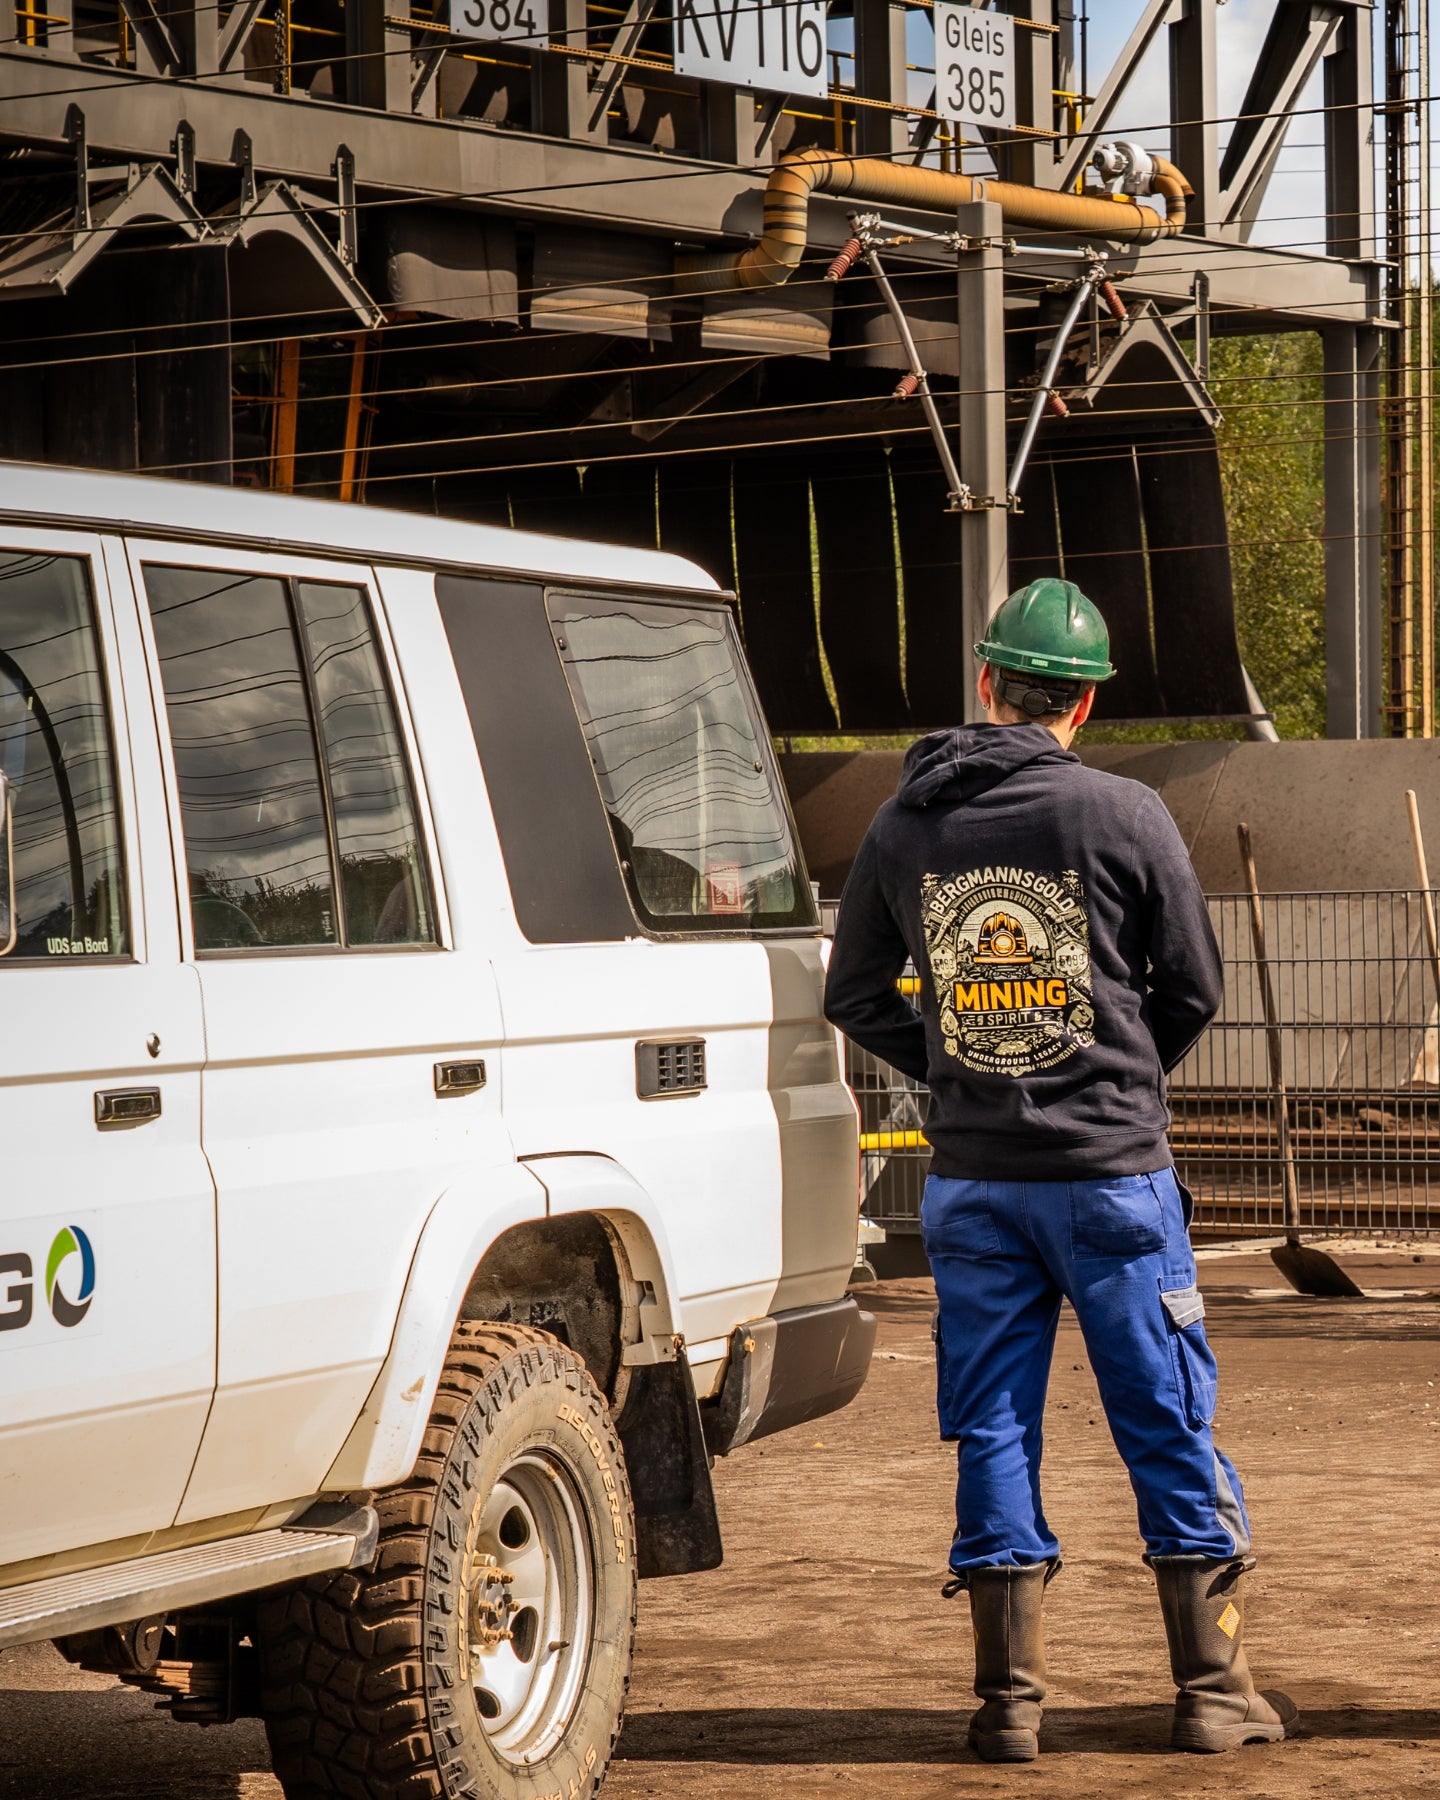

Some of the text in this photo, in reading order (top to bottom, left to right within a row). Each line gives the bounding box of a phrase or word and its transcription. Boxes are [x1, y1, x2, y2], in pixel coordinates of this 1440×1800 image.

[464, 0, 536, 36] 384
[945, 13, 1005, 56] Gleis
[947, 63, 1005, 118] 385
[929, 866, 1075, 914] BERGMANNSGOLD
[47, 937, 109, 954] UDS an Bord
[956, 980, 1067, 1011] MINING
[987, 1011, 1030, 1026] SPIRIT
[967, 1041, 1062, 1066] UNDERGROUND LEGACY
[556, 1402, 626, 1564] DISCOVERER
